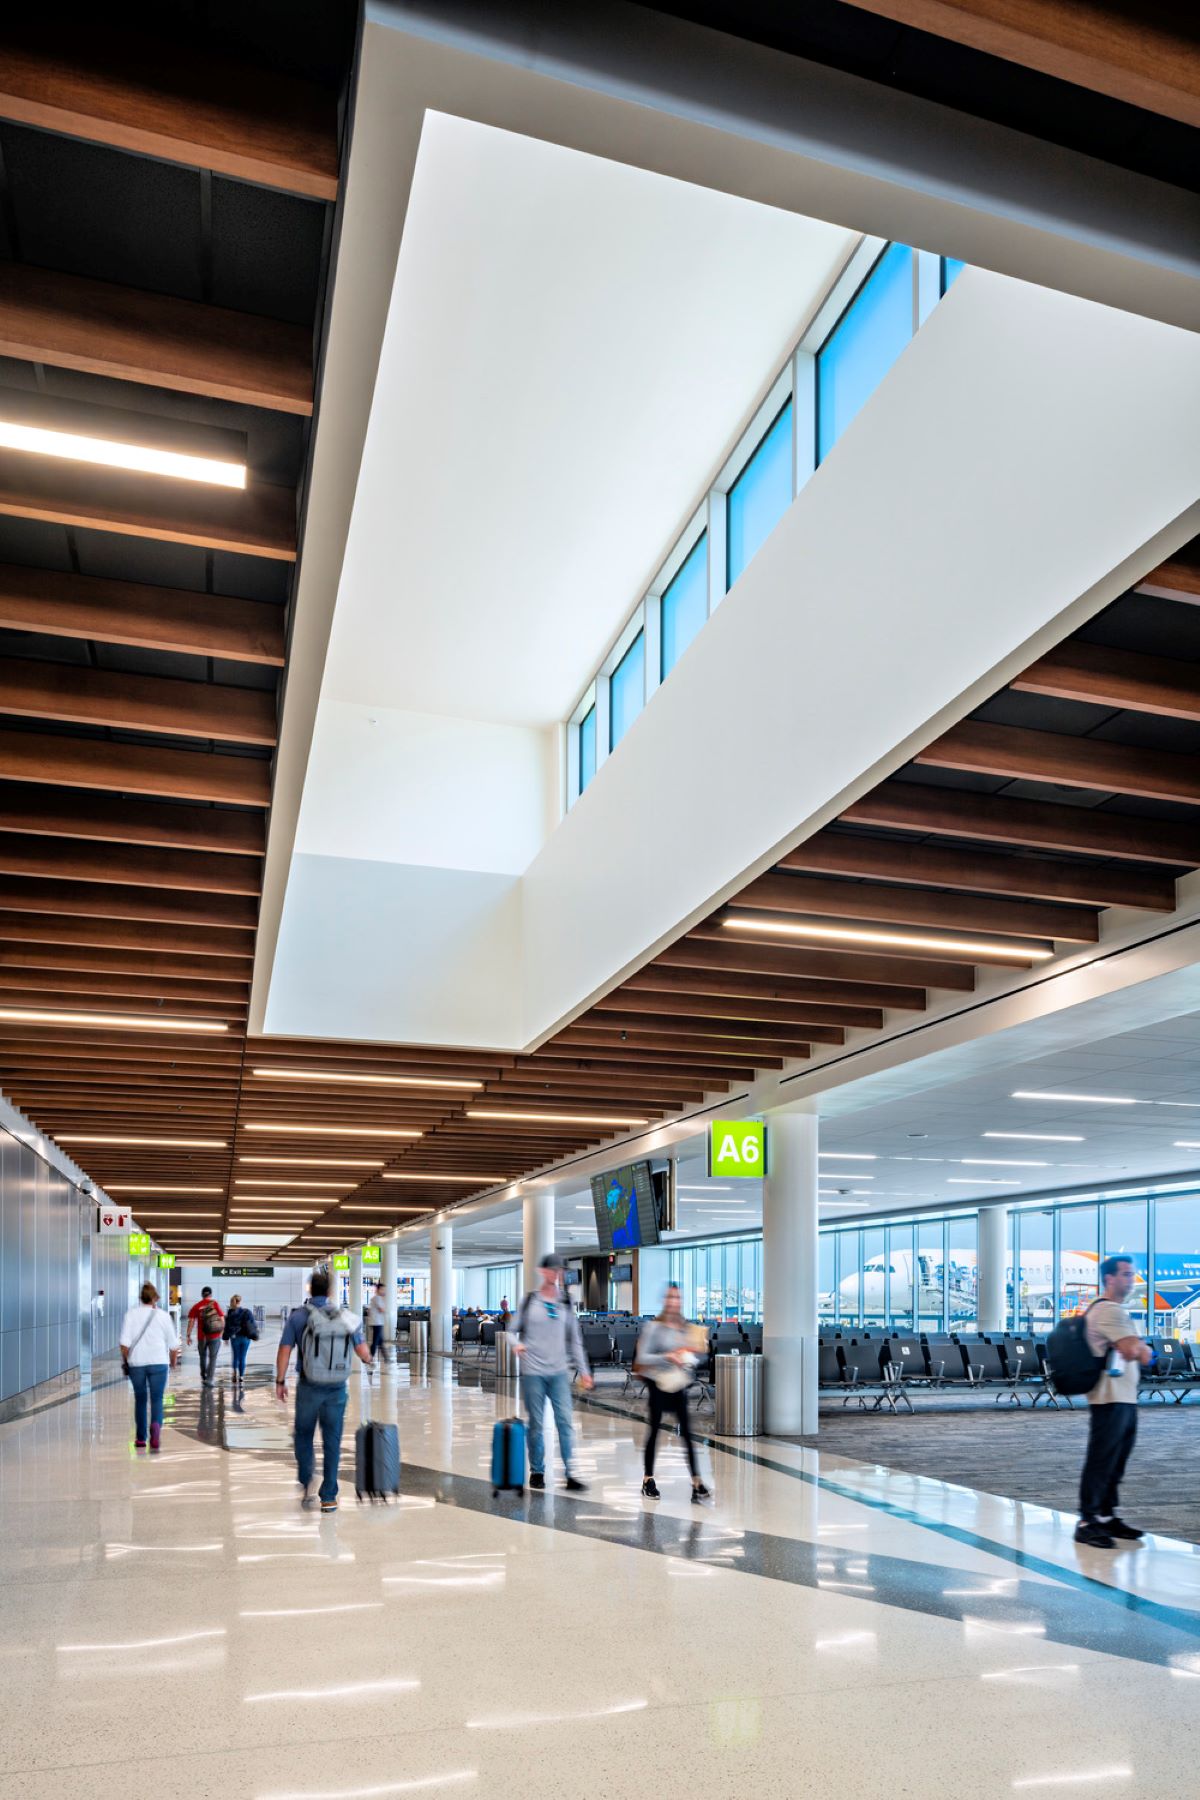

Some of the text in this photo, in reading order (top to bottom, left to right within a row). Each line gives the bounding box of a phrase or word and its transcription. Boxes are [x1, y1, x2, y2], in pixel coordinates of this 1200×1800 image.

[717, 1134, 760, 1164] A6
[364, 1250, 379, 1260] A5
[335, 1259, 347, 1267] A4
